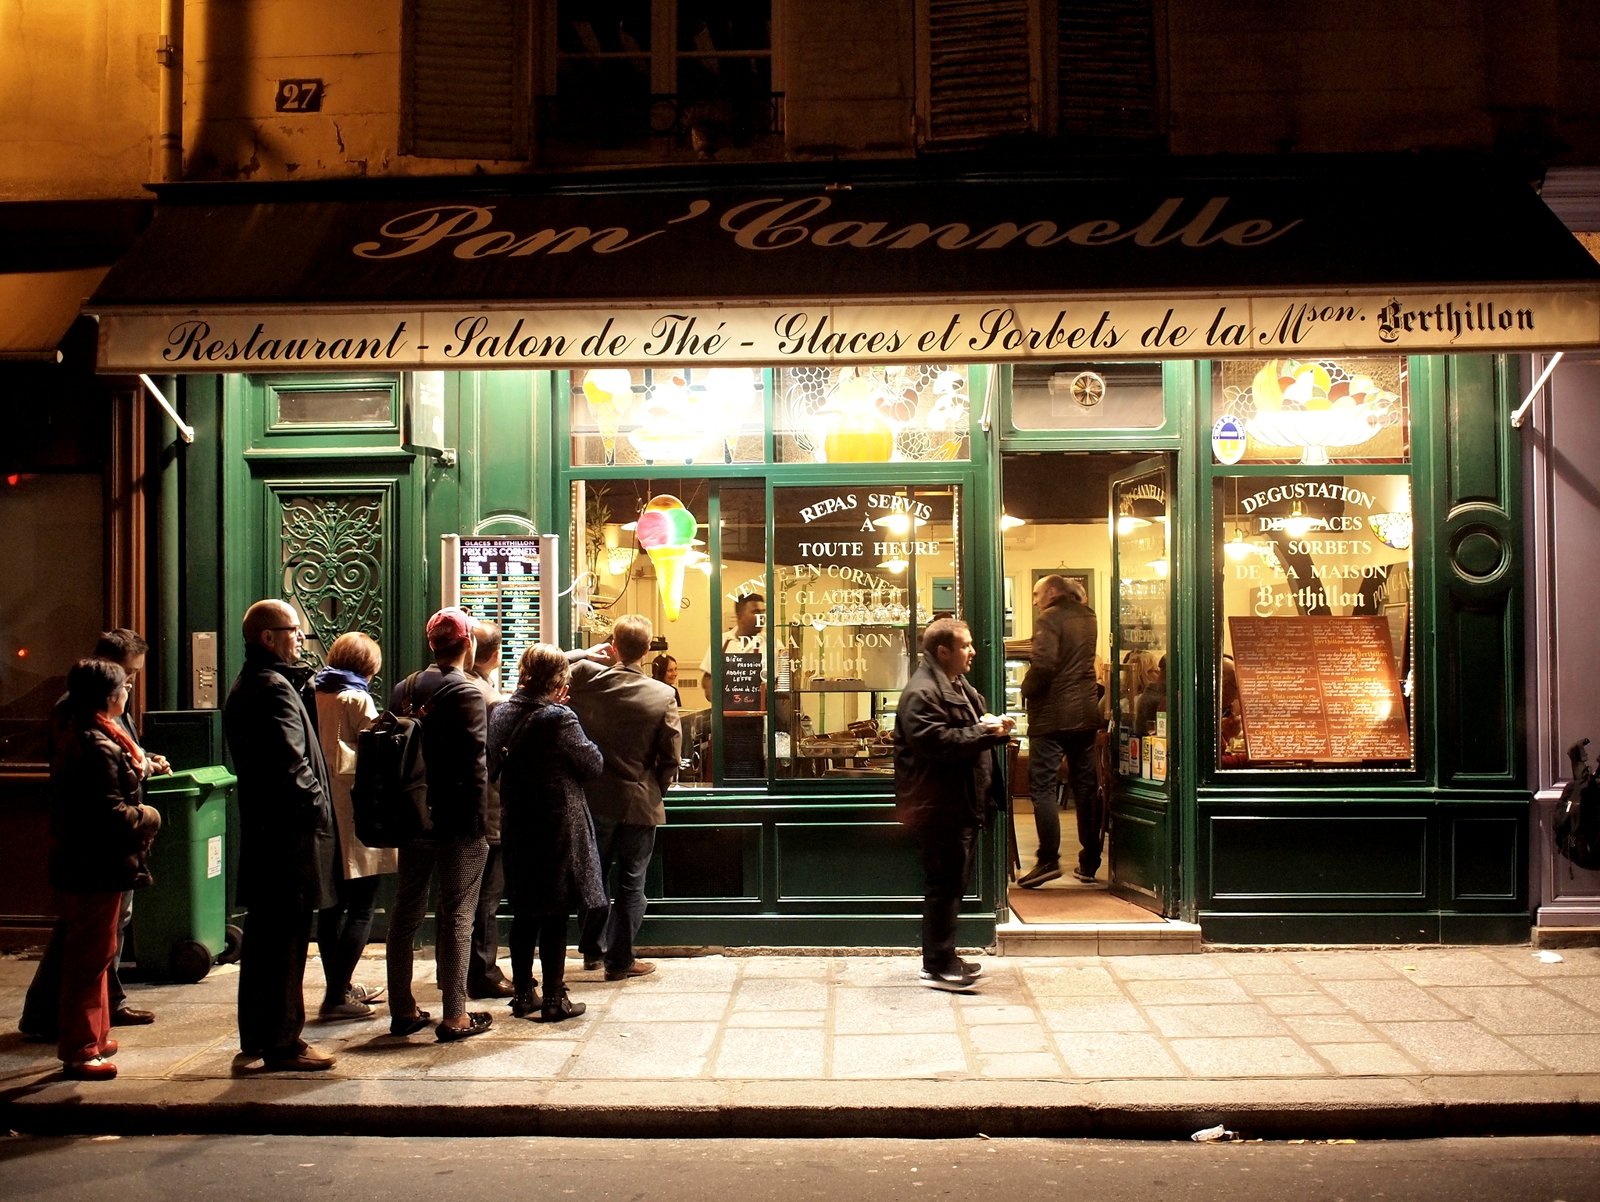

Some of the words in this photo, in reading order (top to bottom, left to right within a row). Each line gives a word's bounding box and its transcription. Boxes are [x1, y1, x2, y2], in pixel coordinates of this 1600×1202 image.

[282, 83, 318, 109] 27
[719, 196, 1304, 251] Cannelle
[162, 320, 408, 362] Restaurant
[443, 315, 578, 358] Salon
[581, 317, 637, 357] de
[643, 314, 732, 356] Thé
[774, 312, 913, 355] Glaces
[917, 313, 963, 352] et
[968, 308, 1130, 351] Sorbets
[1140, 308, 1197, 348] de
[1205, 306, 1255, 347] la
[1376, 297, 1536, 345] Berthillon
[1241, 482, 1377, 514] DEGUSTATION
[799, 493, 858, 524] REPAS
[867, 493, 934, 521] SERVIS
[462, 547, 481, 556] PRIX
[481, 547, 498, 556] DES
[798, 541, 864, 557] TOUTE
[873, 541, 941, 556] HEURE
[1288, 540, 1373, 555] SORBETS
[792, 563, 823, 578] EN
[1236, 565, 1261, 580] DE
[1273, 565, 1300, 580] LA
[1311, 565, 1388, 580] MAISON
[795, 590, 864, 606] GLACES
[1254, 581, 1366, 618] Berthillon
[813, 633, 894, 648] MAISON
